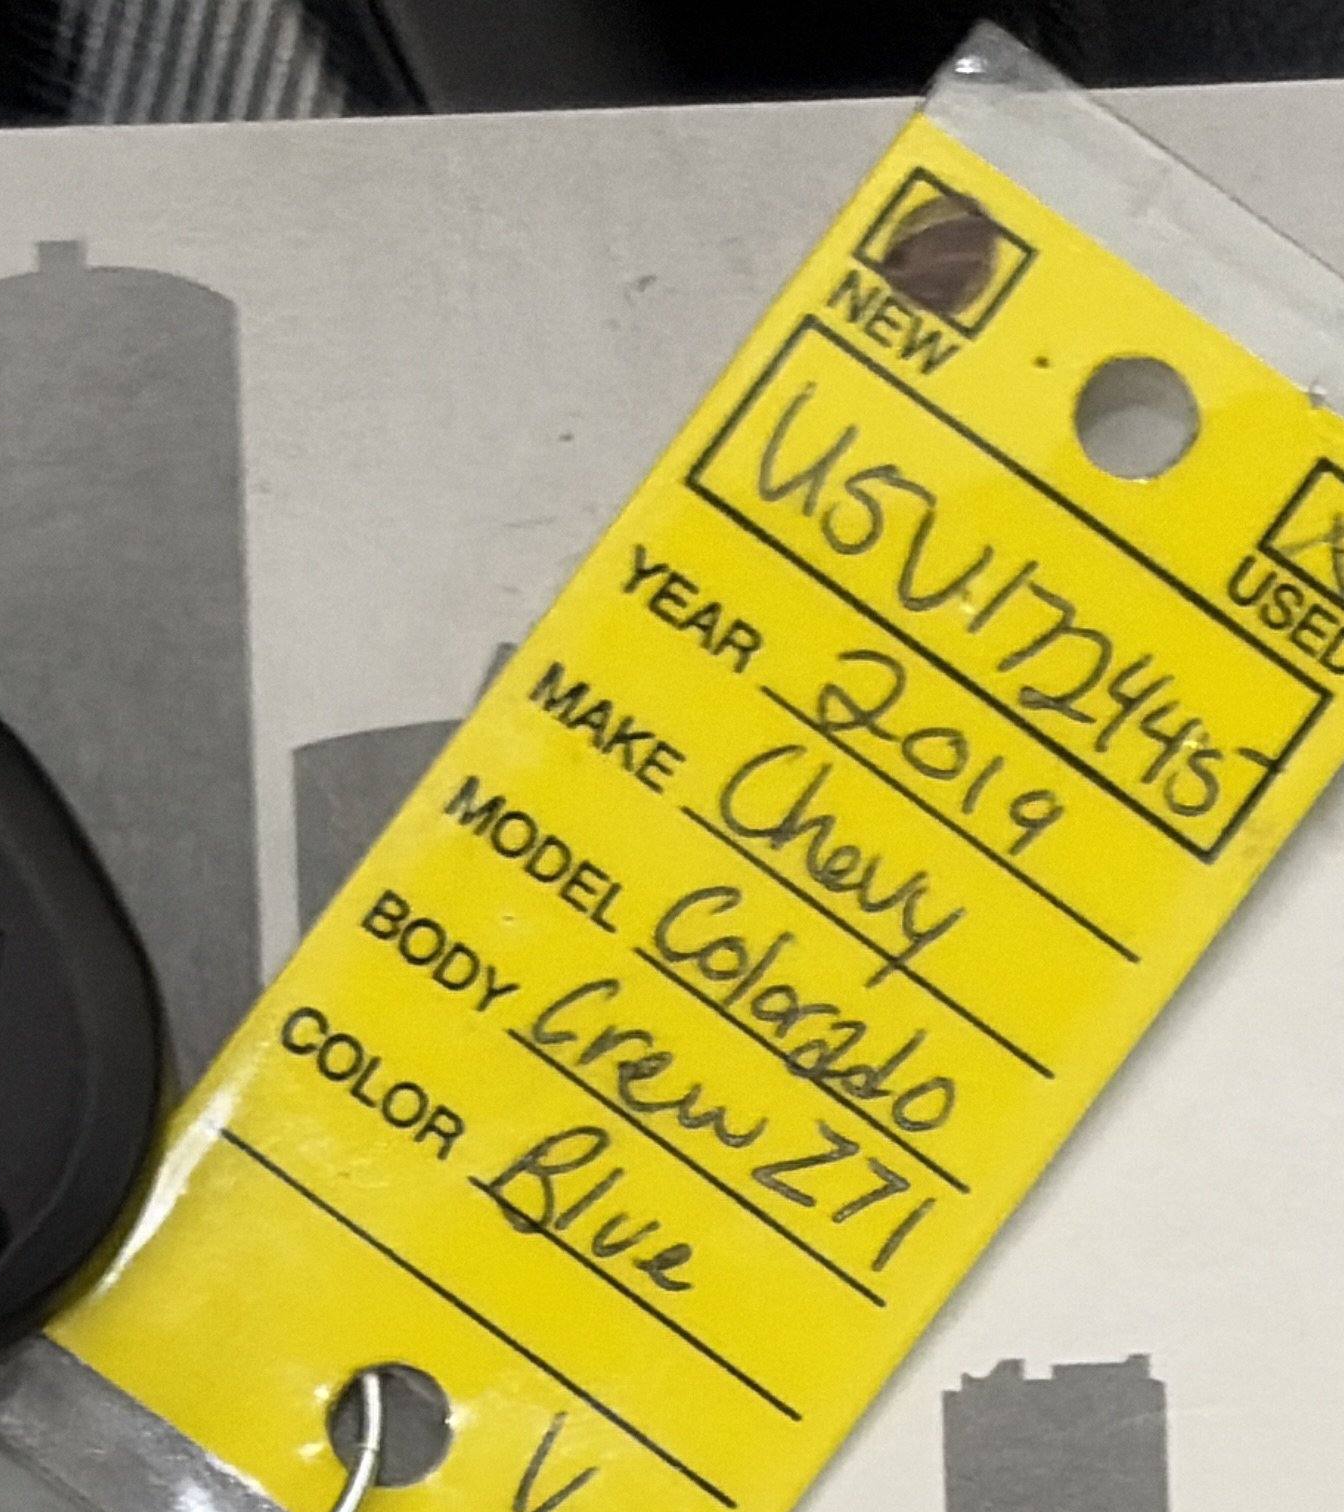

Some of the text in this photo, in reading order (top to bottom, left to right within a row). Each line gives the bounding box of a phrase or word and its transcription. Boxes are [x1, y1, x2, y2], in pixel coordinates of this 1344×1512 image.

[828, 270, 960, 374] NEW
[623, 544, 764, 674] YEAR
[528, 662, 686, 794] MAKE
[816, 650, 1064, 856] 2019
[444, 775, 624, 934] MODEL
[720, 744, 966, 988] Chevy
[360, 890, 520, 1013] BODY
[653, 885, 956, 1132] Colorado
[280, 1005, 466, 1161] COLOR
[532, 978, 768, 1148] Crew
[488, 1126, 694, 1292] Blue
